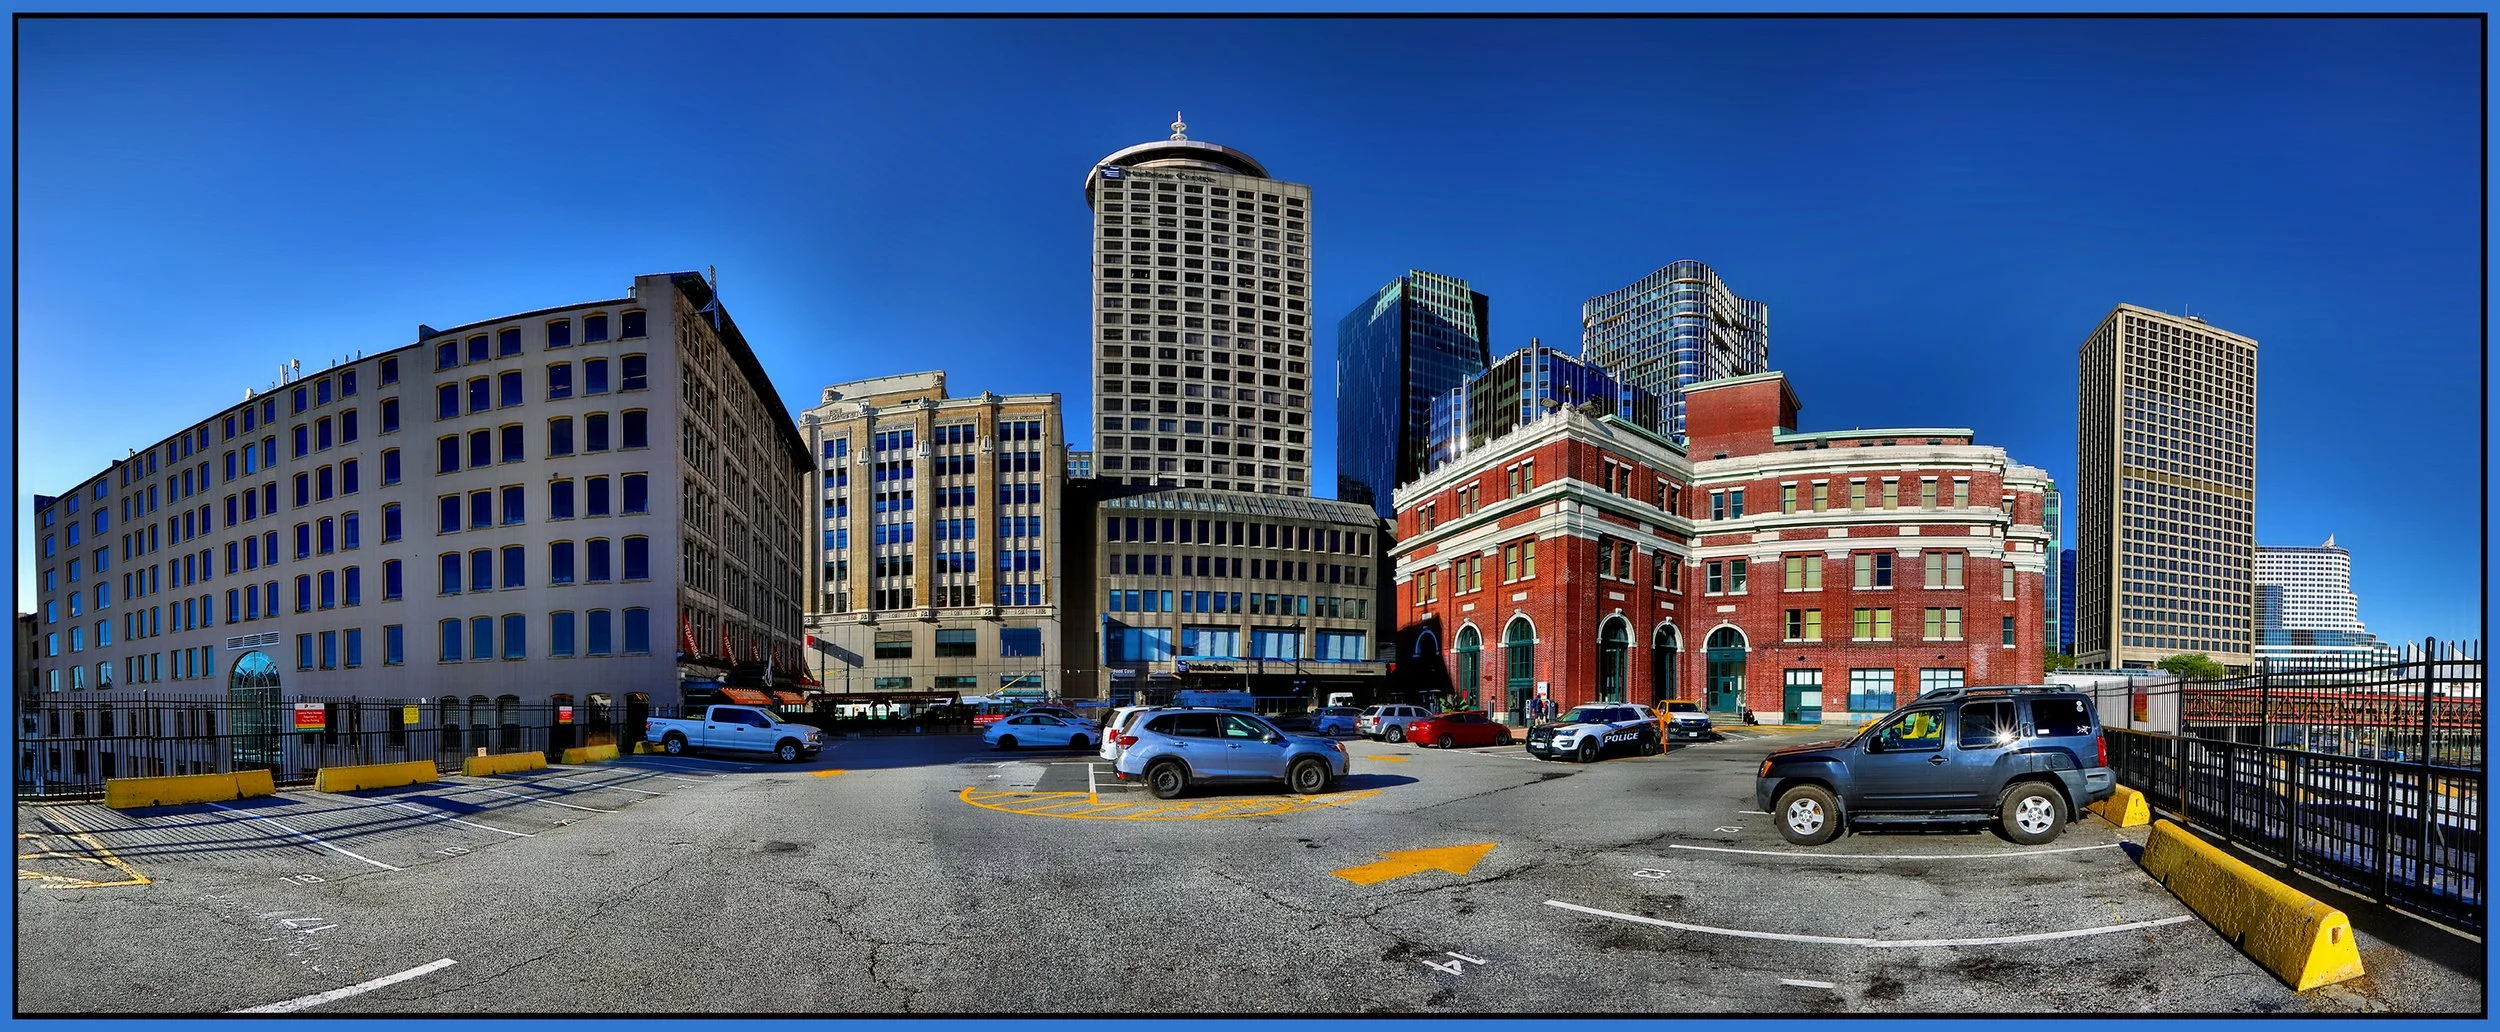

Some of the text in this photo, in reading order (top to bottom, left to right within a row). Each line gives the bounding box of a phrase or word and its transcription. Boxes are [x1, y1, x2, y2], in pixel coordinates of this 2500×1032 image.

[1604, 732, 1639, 743] POLICE
[279, 874, 325, 886] 18
[1421, 951, 1486, 976] 14
